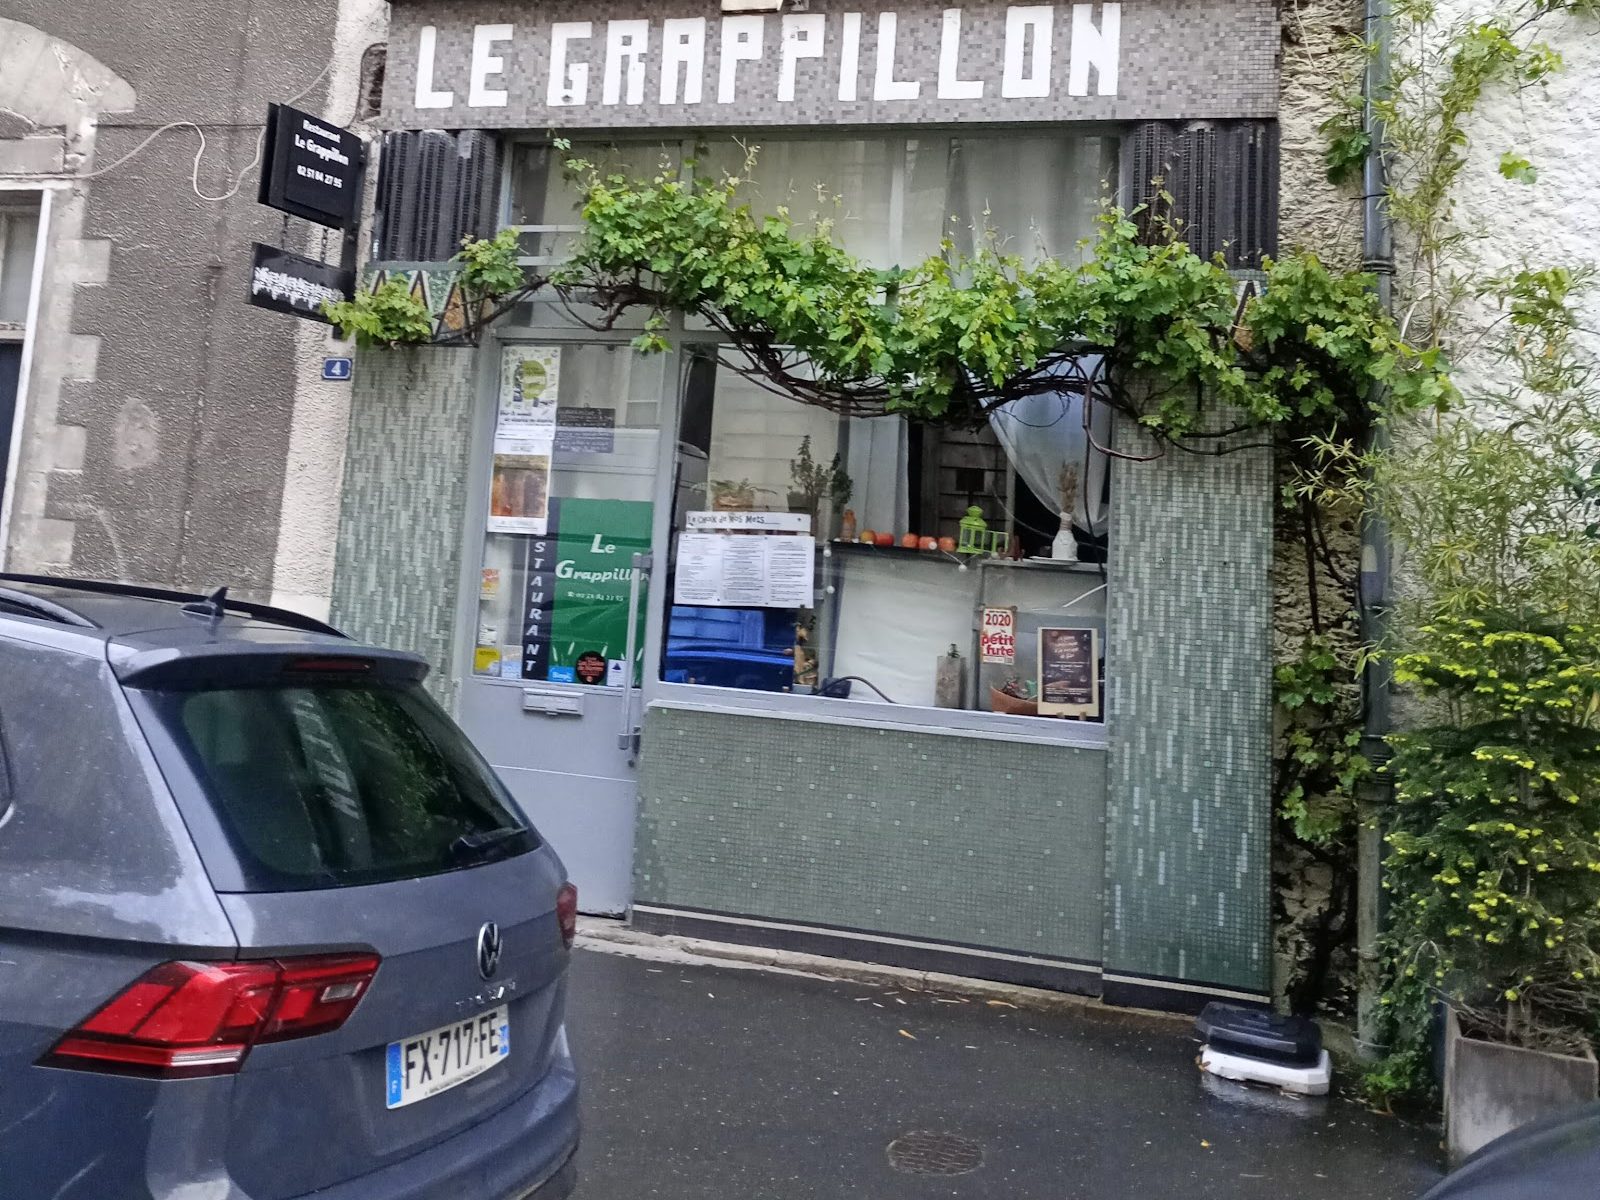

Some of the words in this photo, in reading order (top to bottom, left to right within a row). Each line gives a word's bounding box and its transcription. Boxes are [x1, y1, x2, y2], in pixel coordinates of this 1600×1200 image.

[414, 23, 513, 109] LE
[547, 3, 1122, 106] GRAPPILLON
[295, 133, 306, 149] Le
[306, 139, 349, 166] Grappillon
[331, 361, 341, 375] 4
[590, 533, 616, 554] Le
[555, 559, 649, 583] Grappilln
[985, 613, 1011, 627] 2020
[405, 1012, 498, 1089] FX-717-FE
